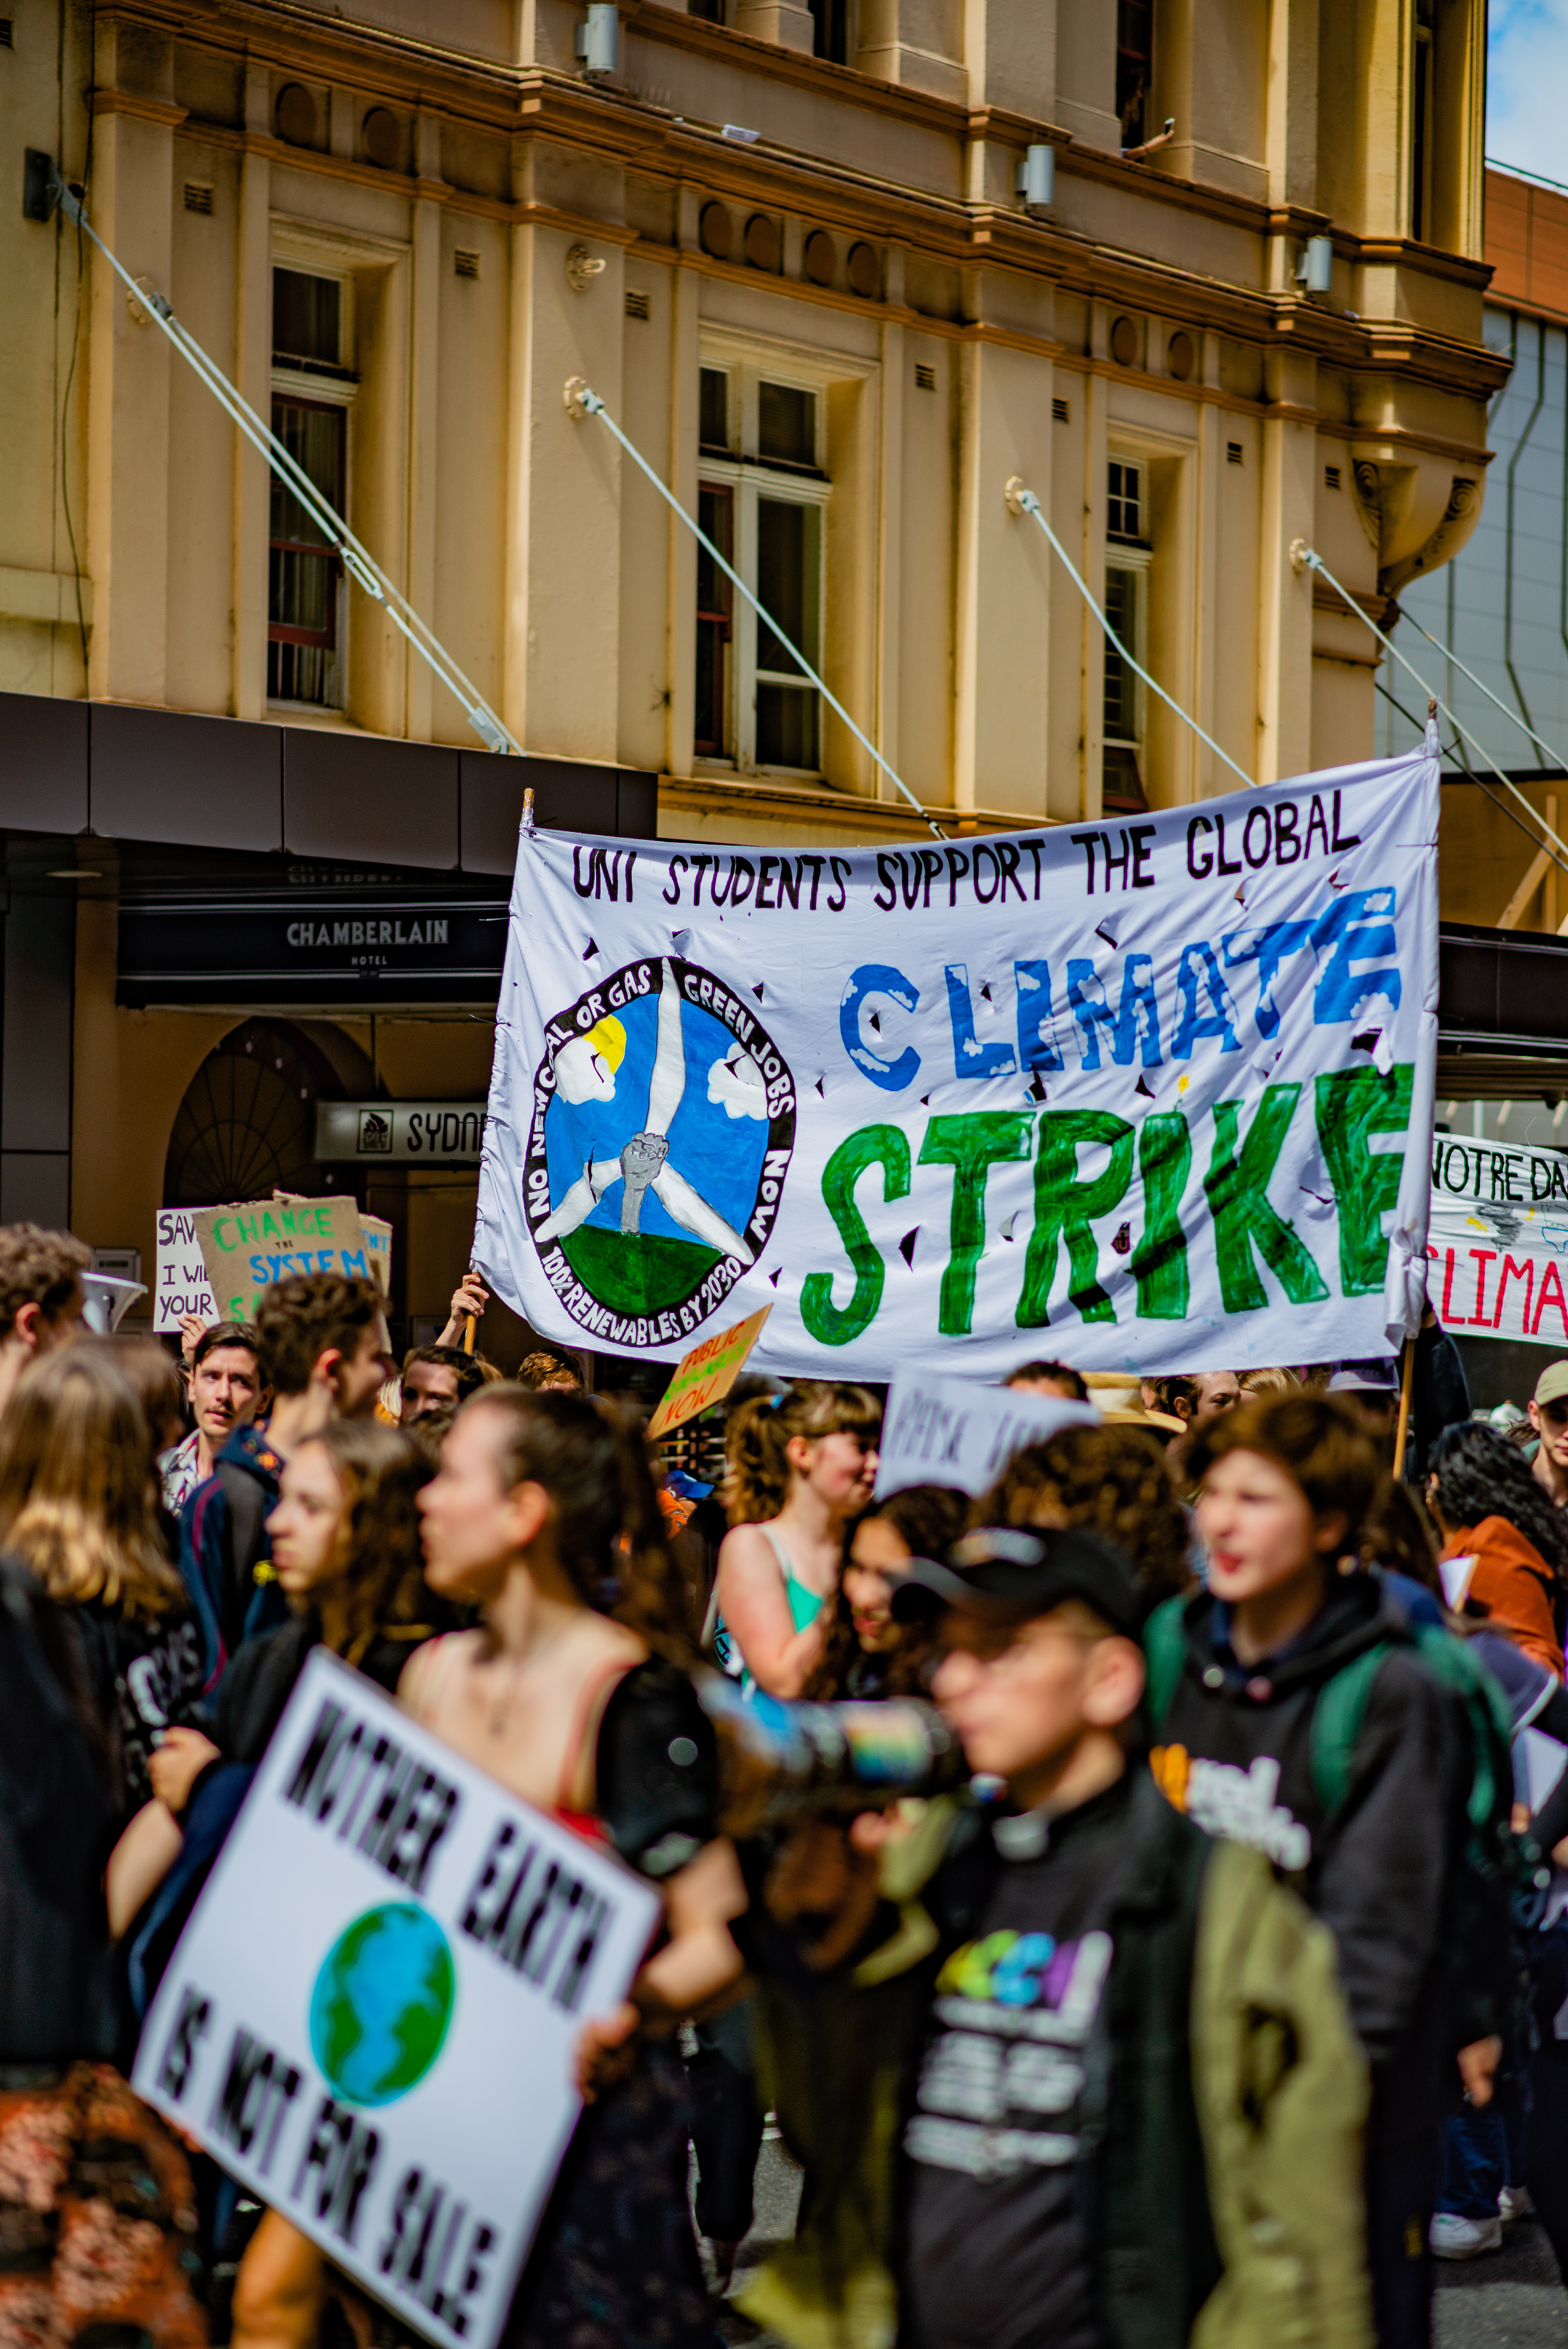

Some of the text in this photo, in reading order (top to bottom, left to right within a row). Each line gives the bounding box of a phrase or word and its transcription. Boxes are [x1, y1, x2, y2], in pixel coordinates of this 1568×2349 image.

[573, 790, 1361, 912] UNI STUDENTS SUPPORT THE GLOBAL
[287, 920, 449, 946] CHAMBERLAIN
[351, 955, 387, 966] HOTEL
[609, 964, 650, 1006] GAS
[839, 886, 1402, 1091] CLIMATE
[577, 993, 606, 1028] OR
[531, 1087, 549, 1157] NEW
[684, 974, 795, 1242] GREEN JOBS NOW
[528, 1169, 550, 1218] NO
[1530, 1157, 1568, 1201] DA
[800, 1063, 1415, 1346] STRIKE
[159, 1214, 198, 1246] SAV
[212, 1207, 335, 1253] CHANGE
[275, 1240, 293, 1249] THE
[162, 1264, 175, 1285] I
[249, 1249, 369, 1284] SYSTEM
[159, 1293, 213, 1323] YOUR
[541, 1246, 741, 1346] 100% RENEWABLES BY 2030
[1427, 1244, 1568, 1340] LIMA
[682, 1321, 745, 1374] PUBLIC
[657, 1375, 719, 1431] NOW
